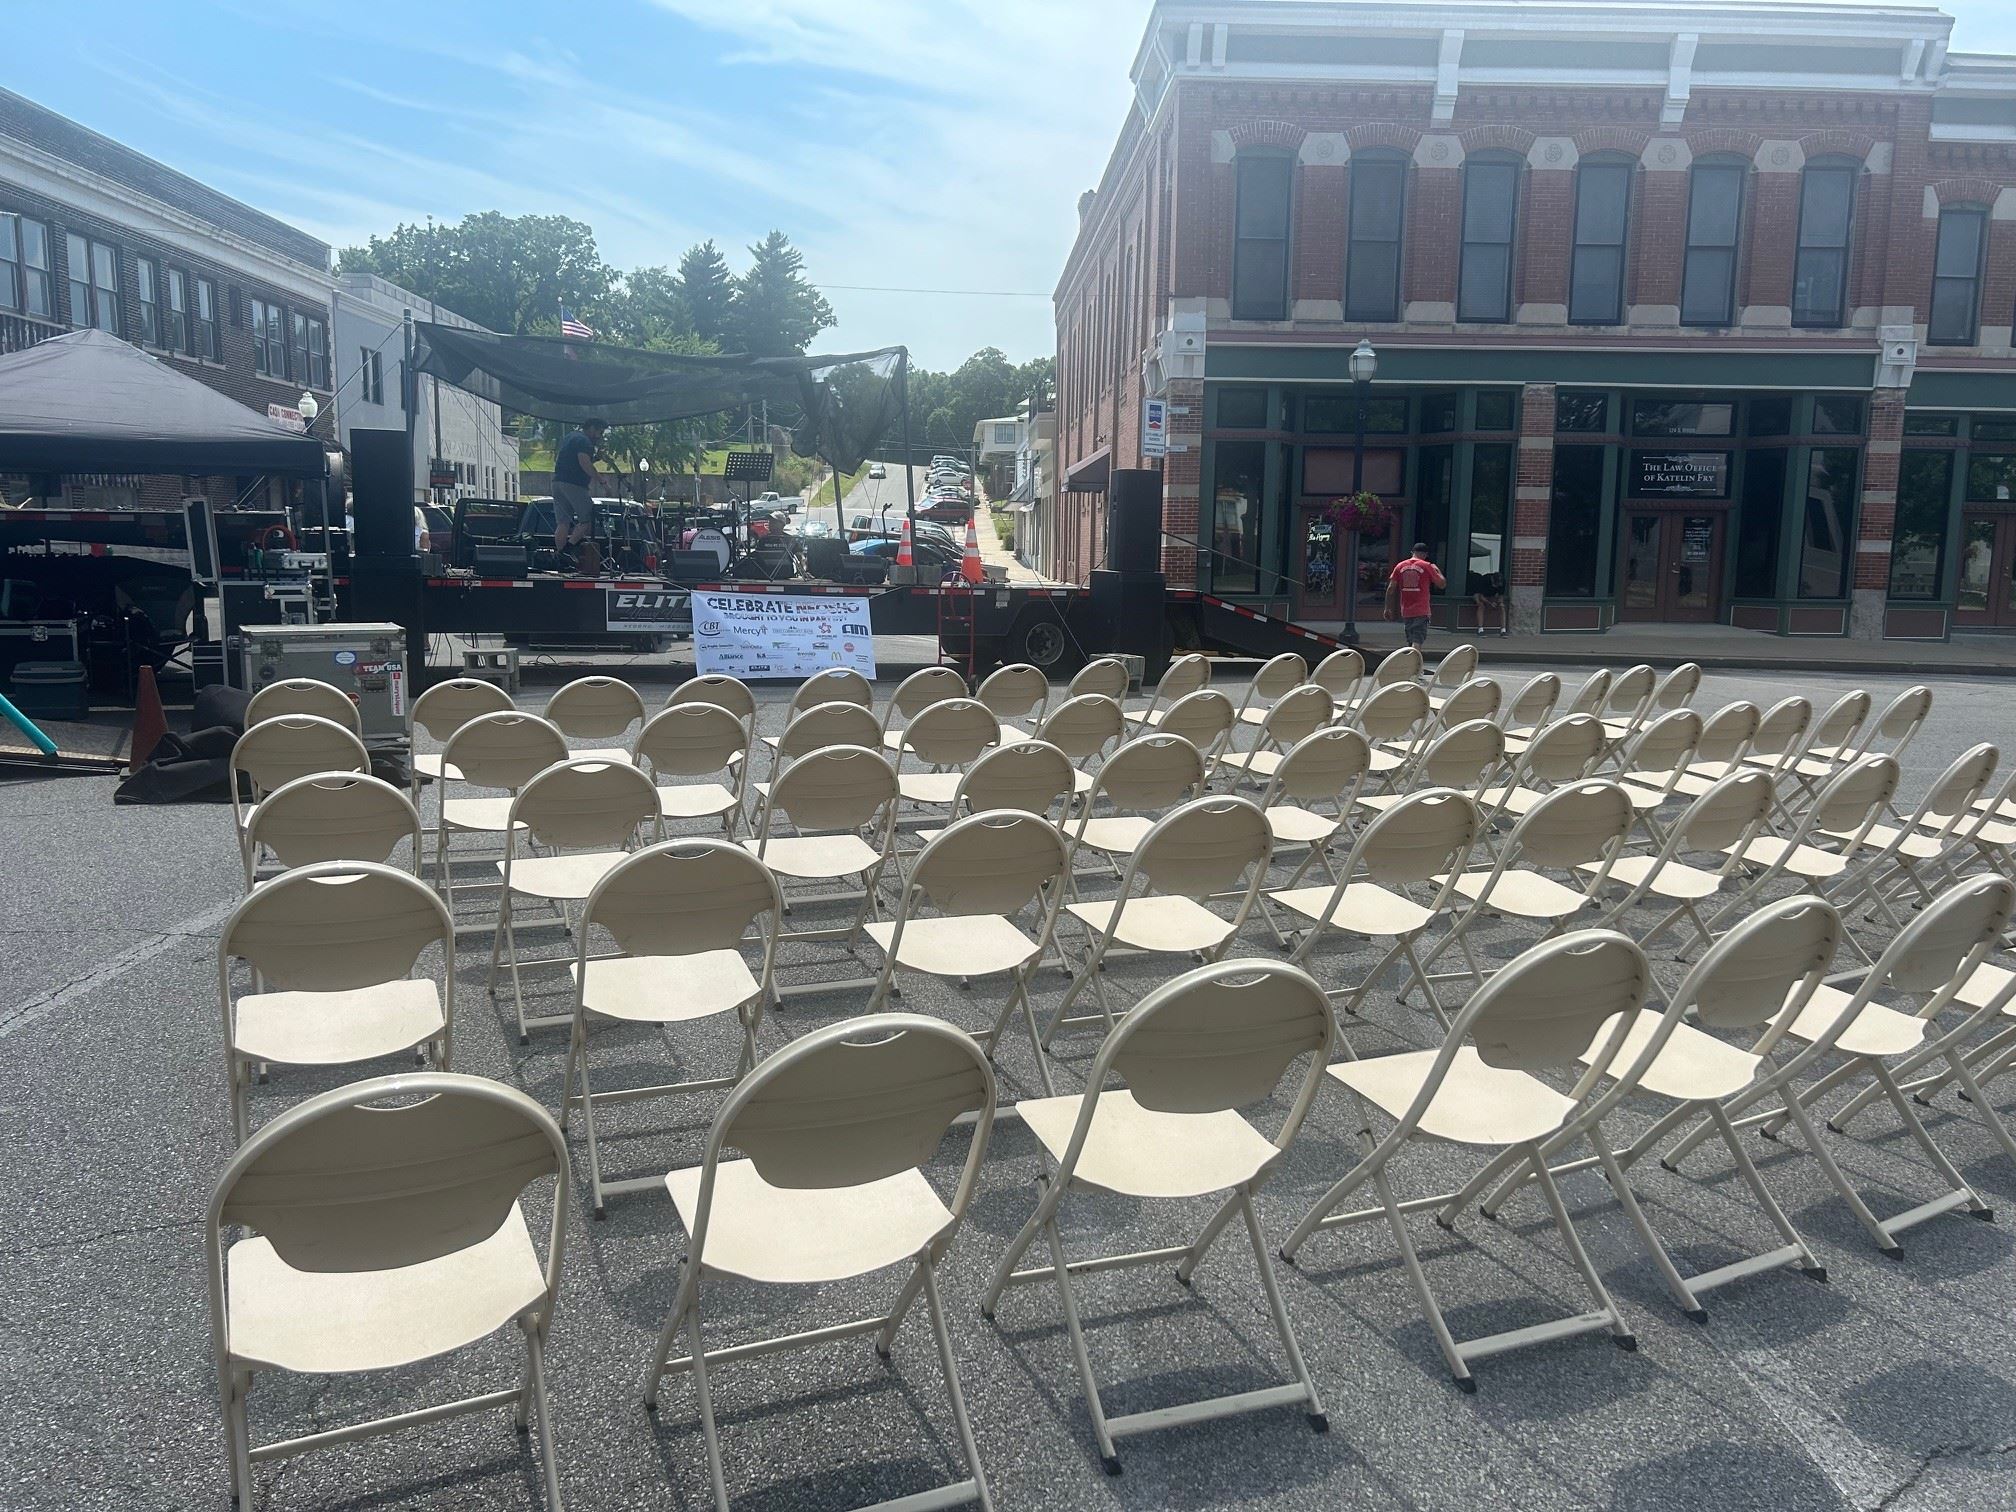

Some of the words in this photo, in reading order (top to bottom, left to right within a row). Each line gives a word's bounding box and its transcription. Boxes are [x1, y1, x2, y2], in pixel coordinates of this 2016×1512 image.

[707, 597, 794, 613] CELEBRATE
[703, 621, 721, 630] CBT
[733, 625, 760, 637] Mercy
[363, 664, 385, 673] TEAM
